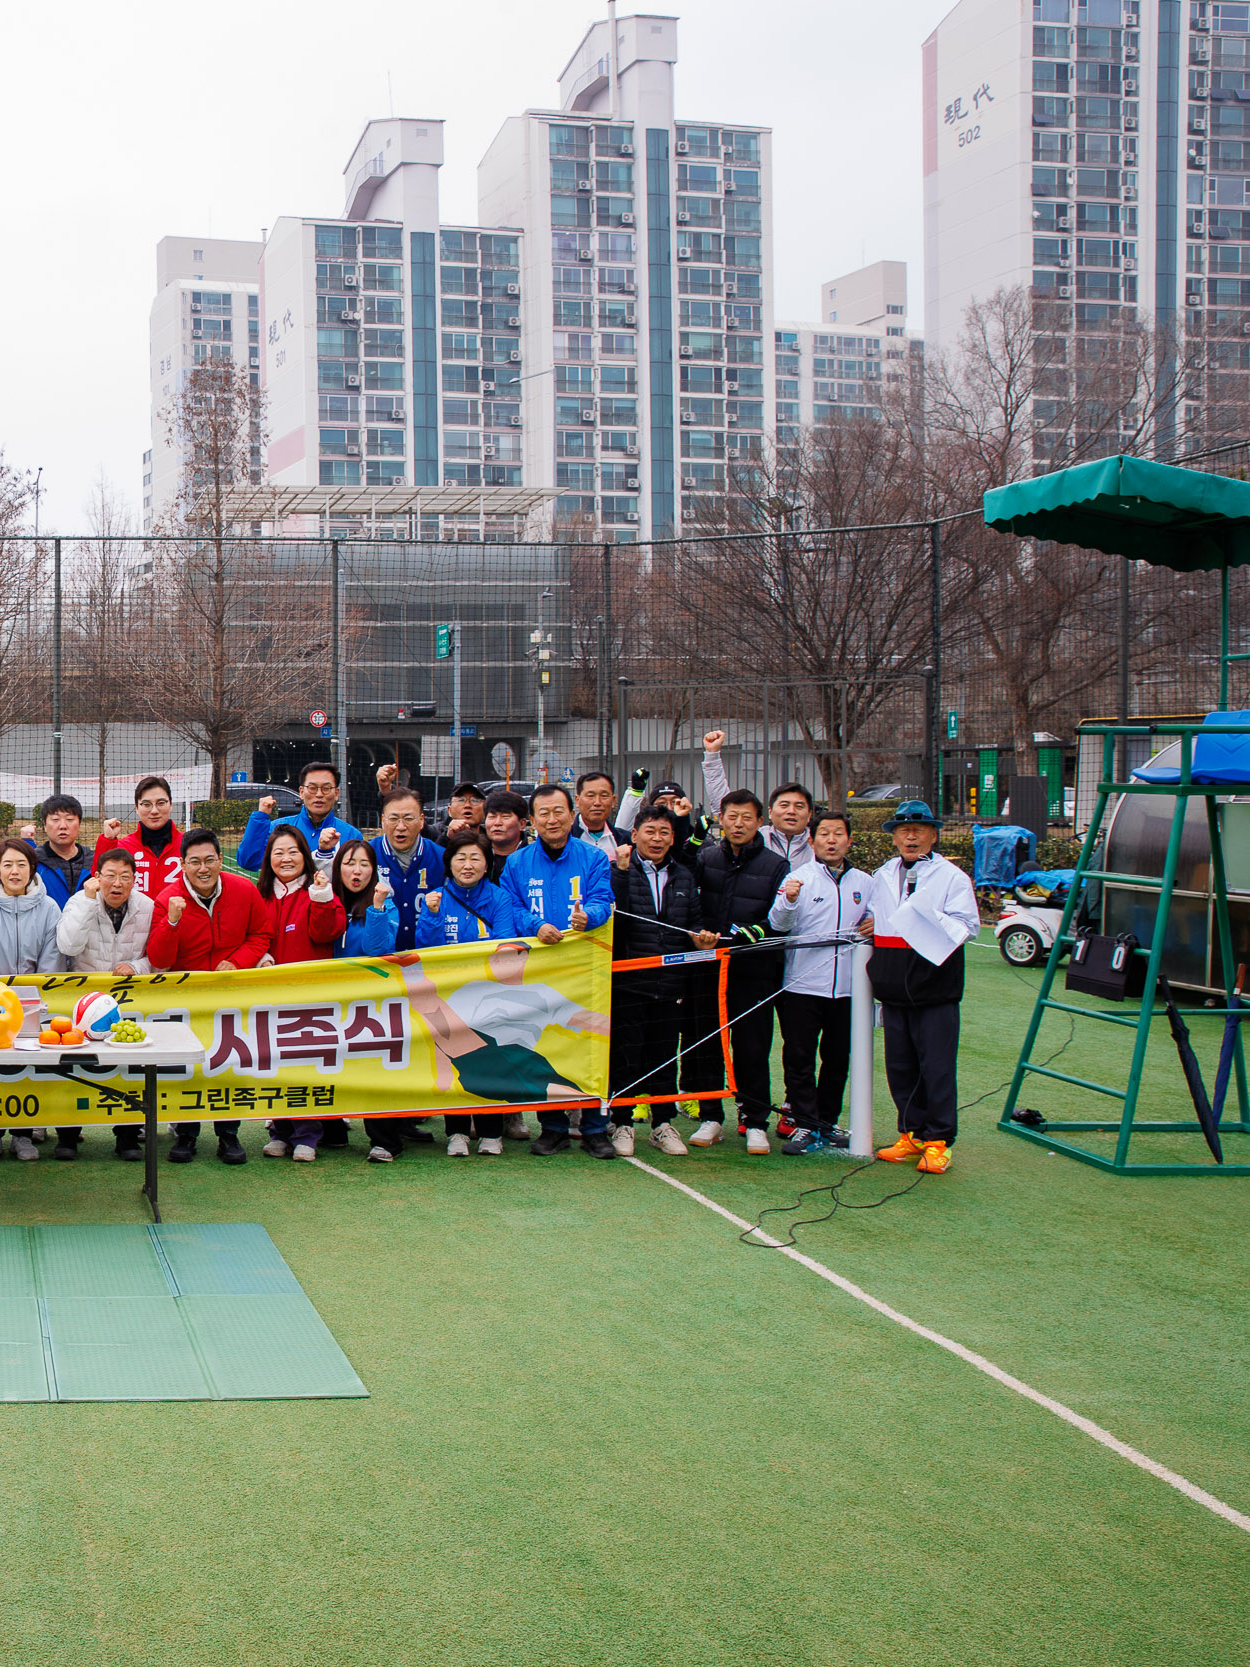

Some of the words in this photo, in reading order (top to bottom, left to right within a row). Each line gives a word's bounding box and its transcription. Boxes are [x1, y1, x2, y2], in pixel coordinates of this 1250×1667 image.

[944, 83, 994, 125] 現代
[958, 125, 981, 148] 502
[164, 856, 182, 883] 2
[417, 868, 428, 889] 1
[569, 876, 582, 900] 1
[1075, 940, 1085, 961] 1
[1112, 946, 1125, 969] 0
[209, 1002, 405, 1071] 시족식
[179, 1084, 336, 1112] 그린족구클럽
